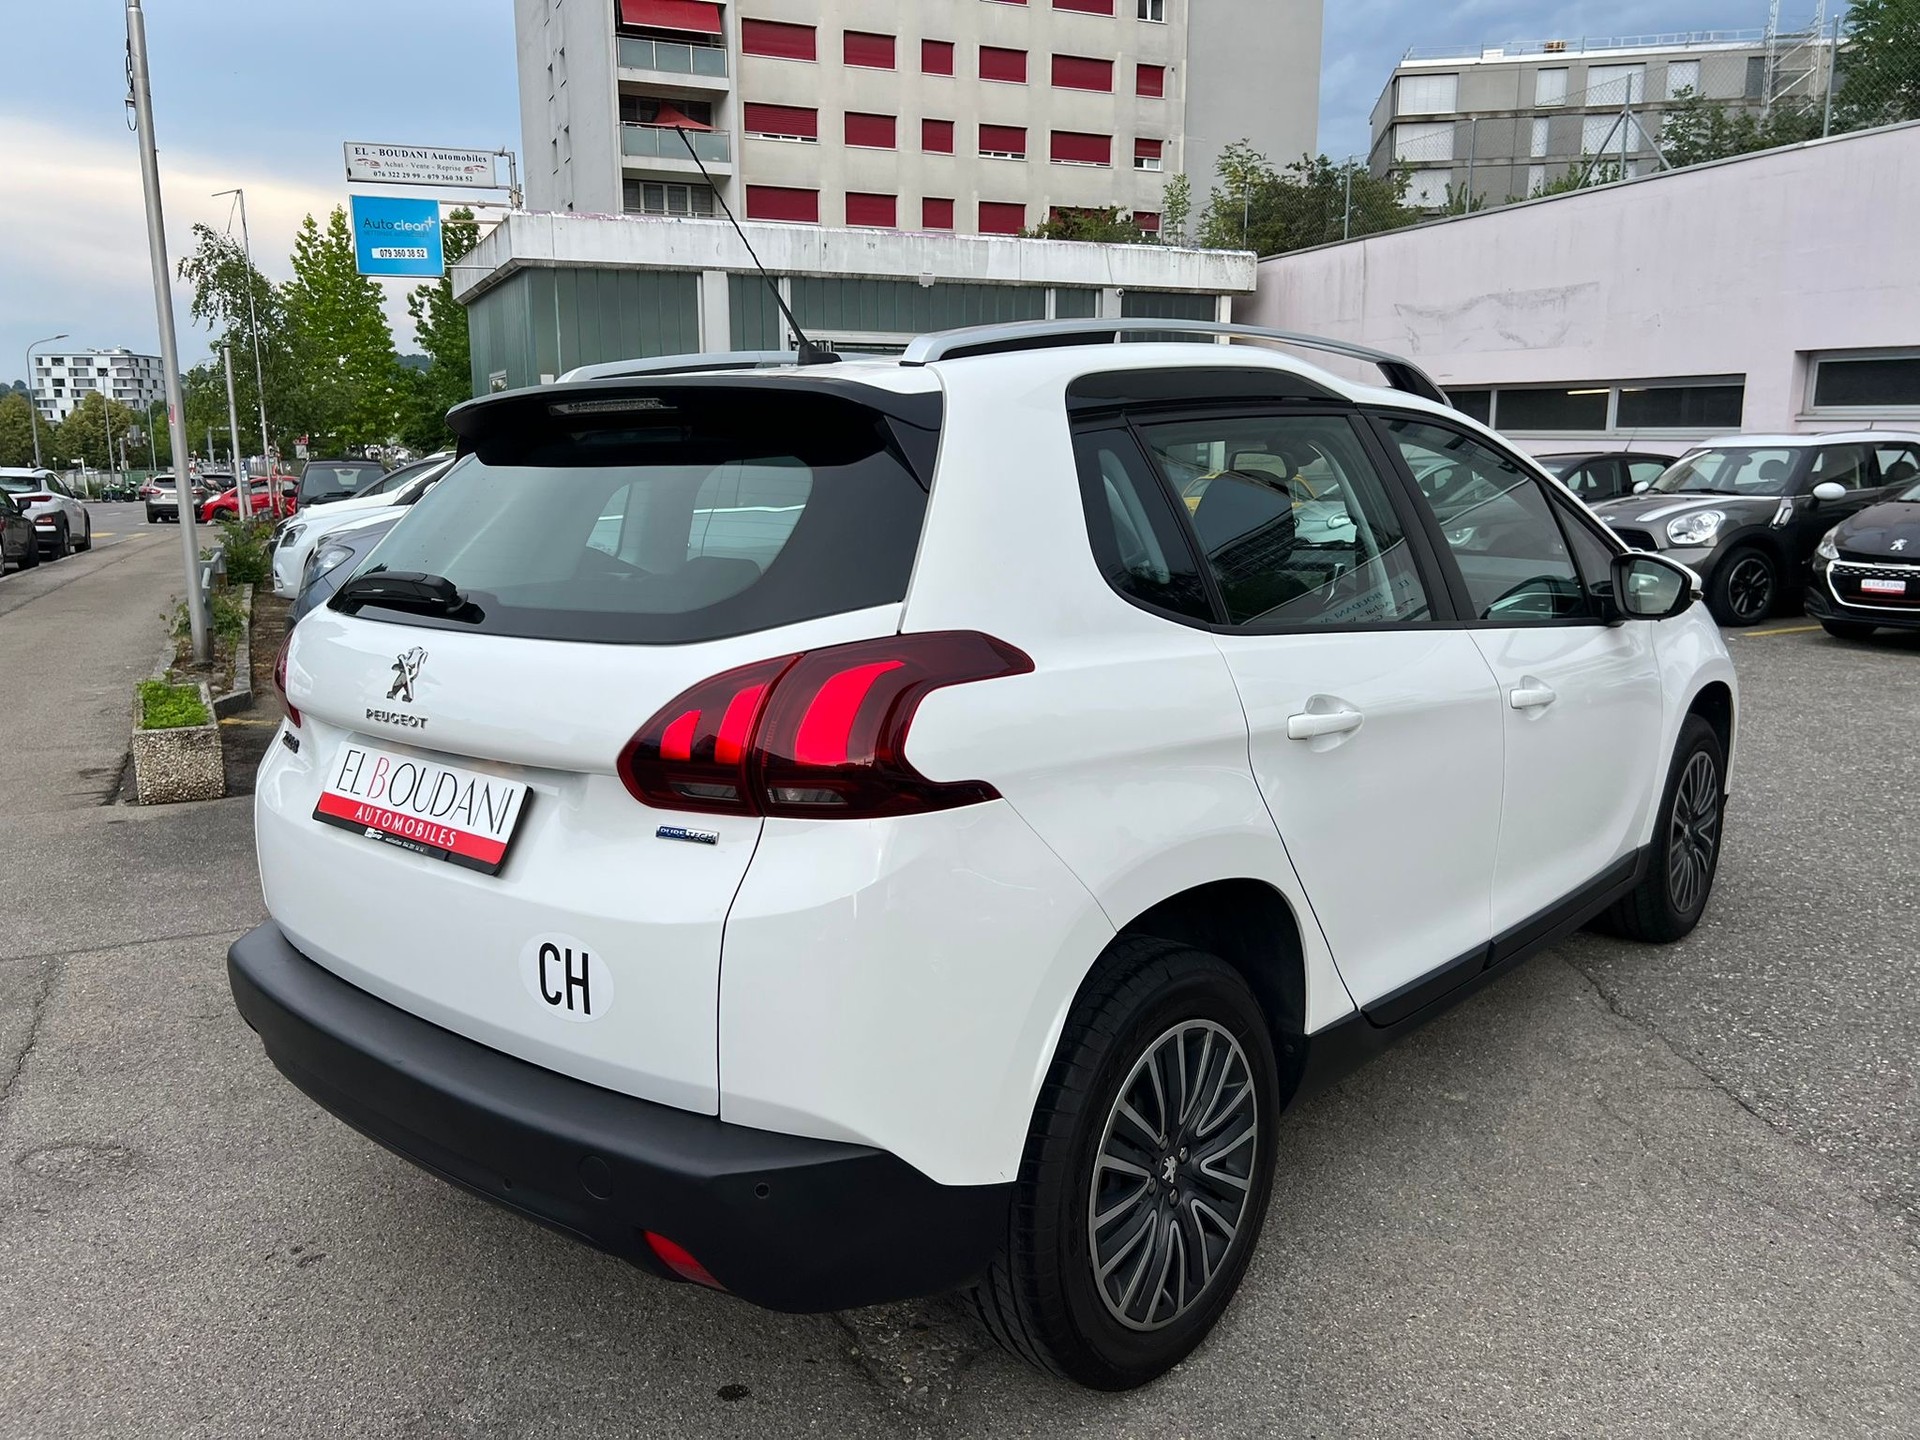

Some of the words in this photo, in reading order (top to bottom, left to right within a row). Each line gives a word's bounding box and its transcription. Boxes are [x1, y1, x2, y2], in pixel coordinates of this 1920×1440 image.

[354, 147, 368, 155] EL
[379, 148, 428, 159] BOUDANI
[431, 152, 487, 162] Automobiles
[388, 170, 400, 178] 322
[379, 249, 392, 258] 079
[406, 249, 416, 258] 38
[416, 249, 425, 258] 52
[365, 708, 429, 730] PEUGEOT
[354, 804, 457, 847] AUTOMOBILES
[538, 941, 592, 1016] CH
